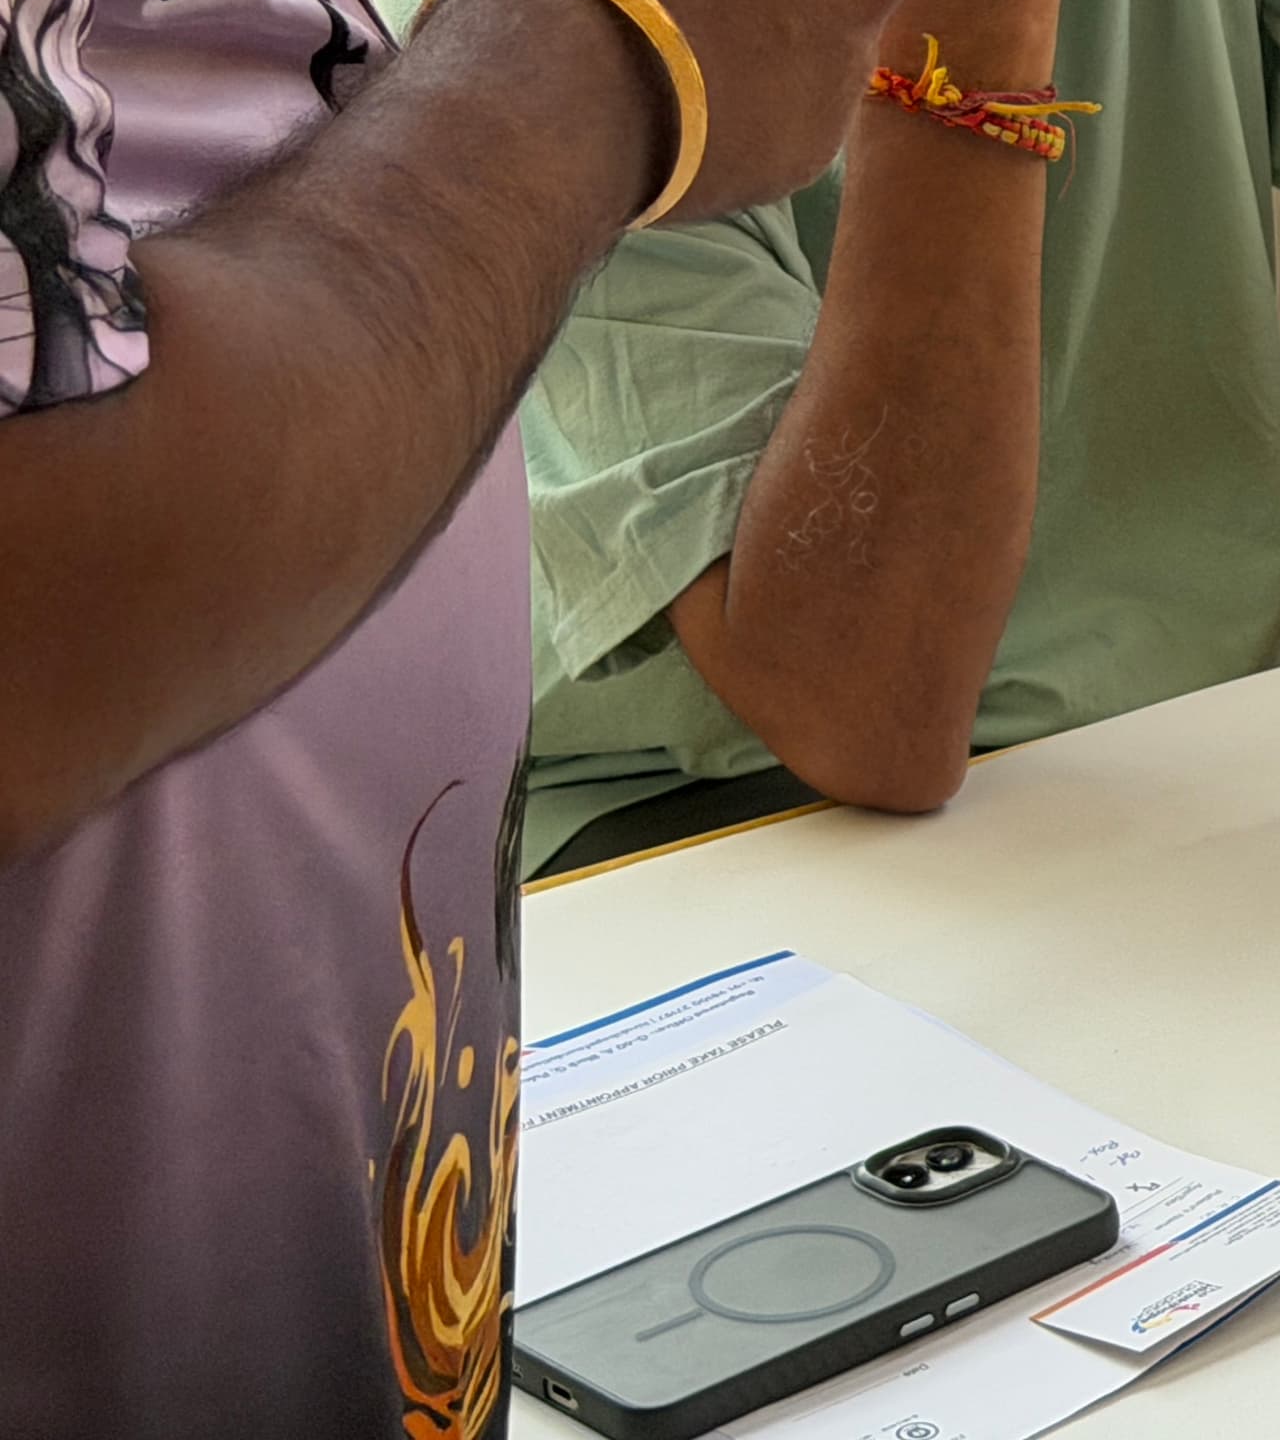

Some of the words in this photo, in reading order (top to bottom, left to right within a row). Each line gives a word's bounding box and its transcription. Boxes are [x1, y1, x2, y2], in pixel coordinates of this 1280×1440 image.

[730, 1019, 784, 1047] PLEASE
[691, 1046, 725, 1066] TAKE
[642, 1063, 686, 1085] PRIOR
[538, 1081, 640, 1123] APPOINTMENT
